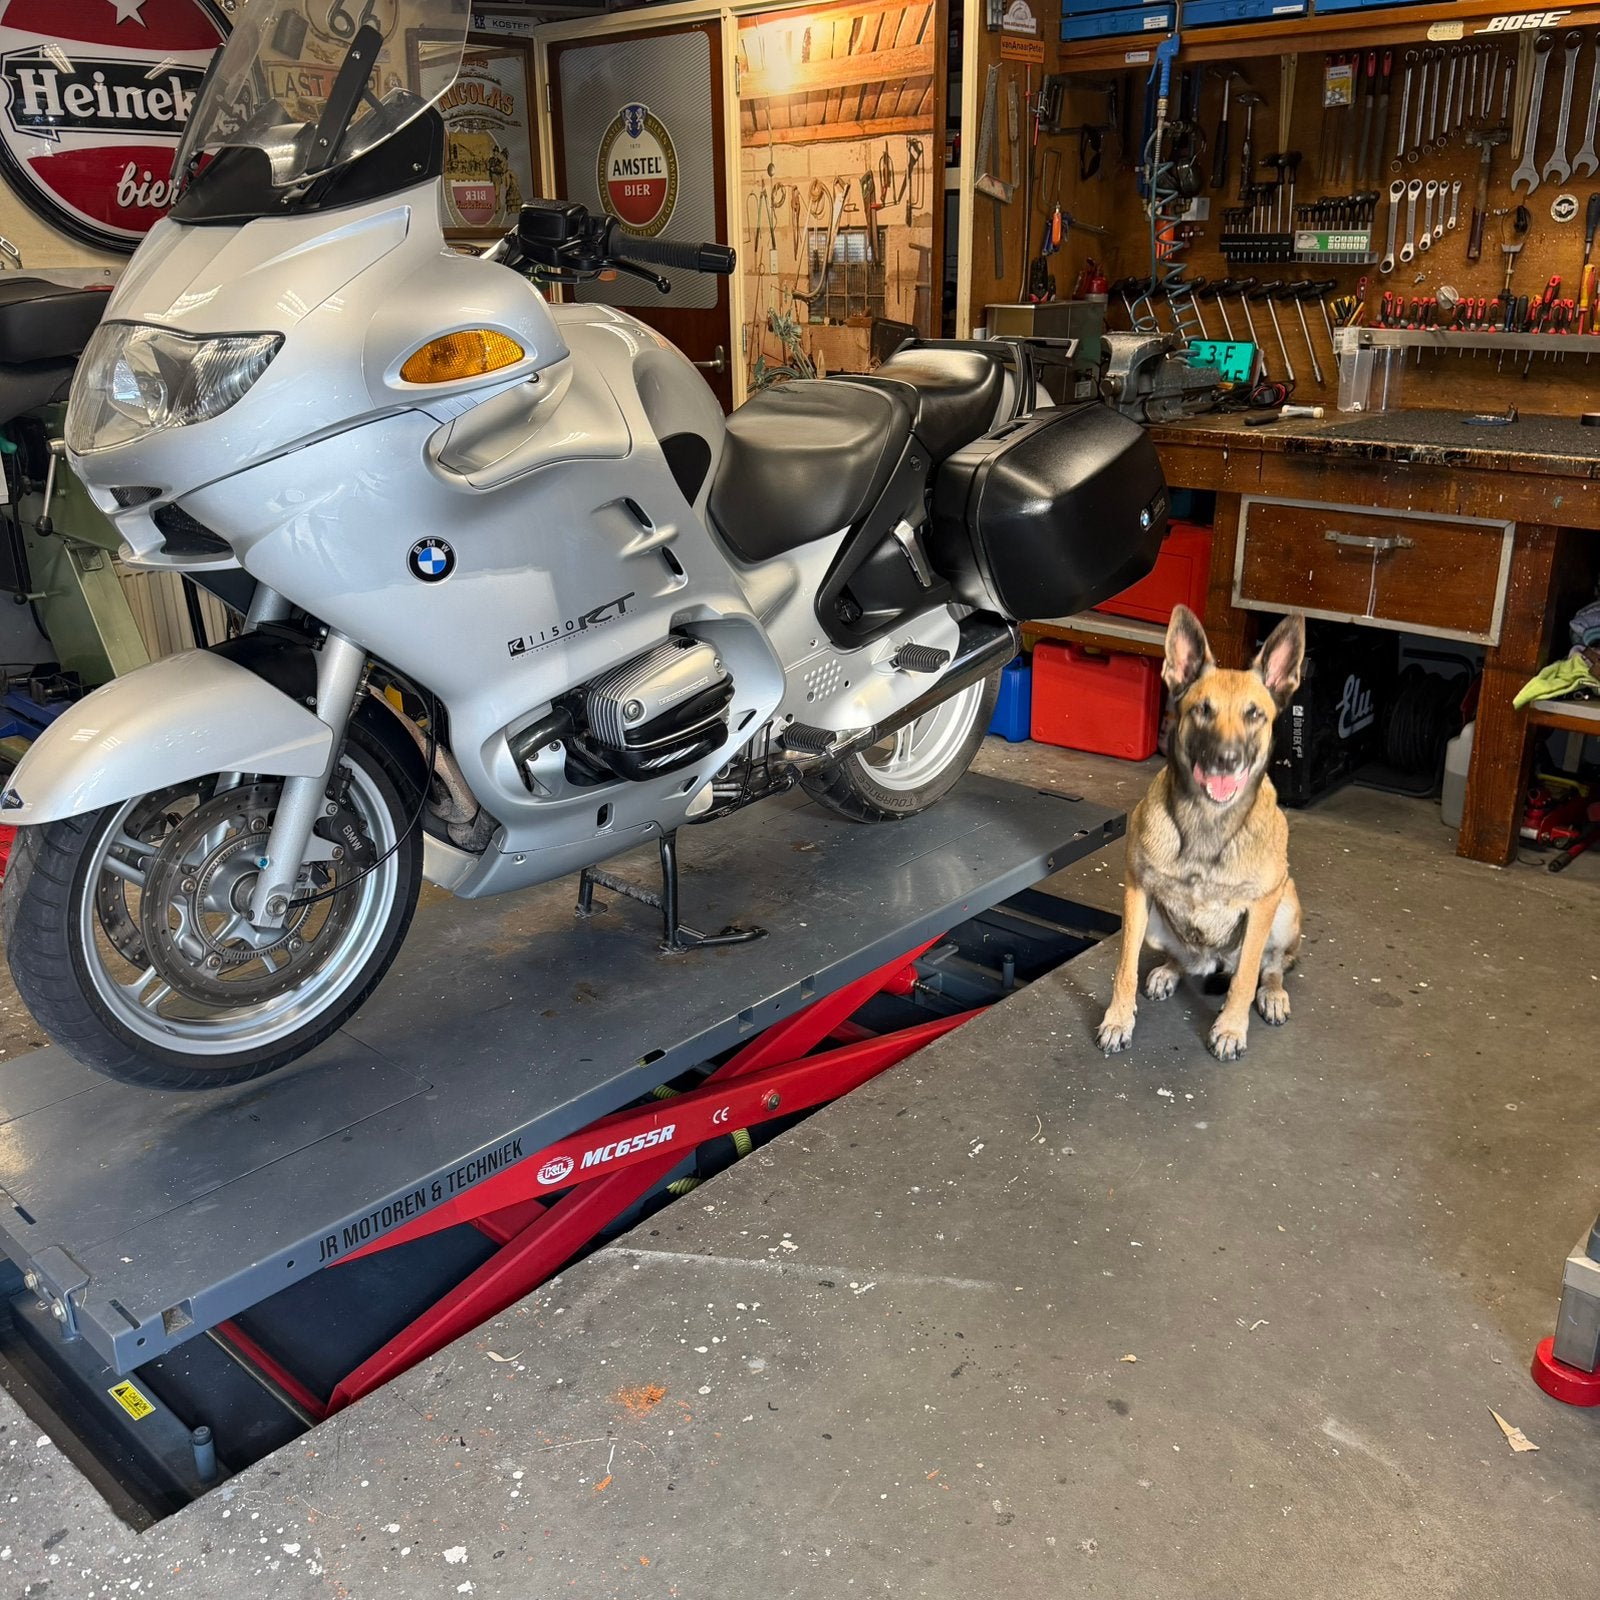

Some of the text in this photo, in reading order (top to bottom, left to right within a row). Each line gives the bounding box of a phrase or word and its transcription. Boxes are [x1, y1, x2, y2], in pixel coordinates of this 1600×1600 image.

[1474, 10, 1571, 33] BOSE
[15, 68, 248, 122] Heinek
[270, 71, 324, 99] LAST
[438, 82, 514, 116] NICOLAS
[612, 156, 662, 176] AMSTEL
[624, 184, 651, 196] BIER
[413, 539, 451, 555] BMW
[857, 776, 914, 807] TOURANCE
[342, 824, 363, 851] BMW
[580, 1124, 676, 1170] MC655R
[319, 1138, 524, 1262] JR MOTOREN & TECHNIEK
